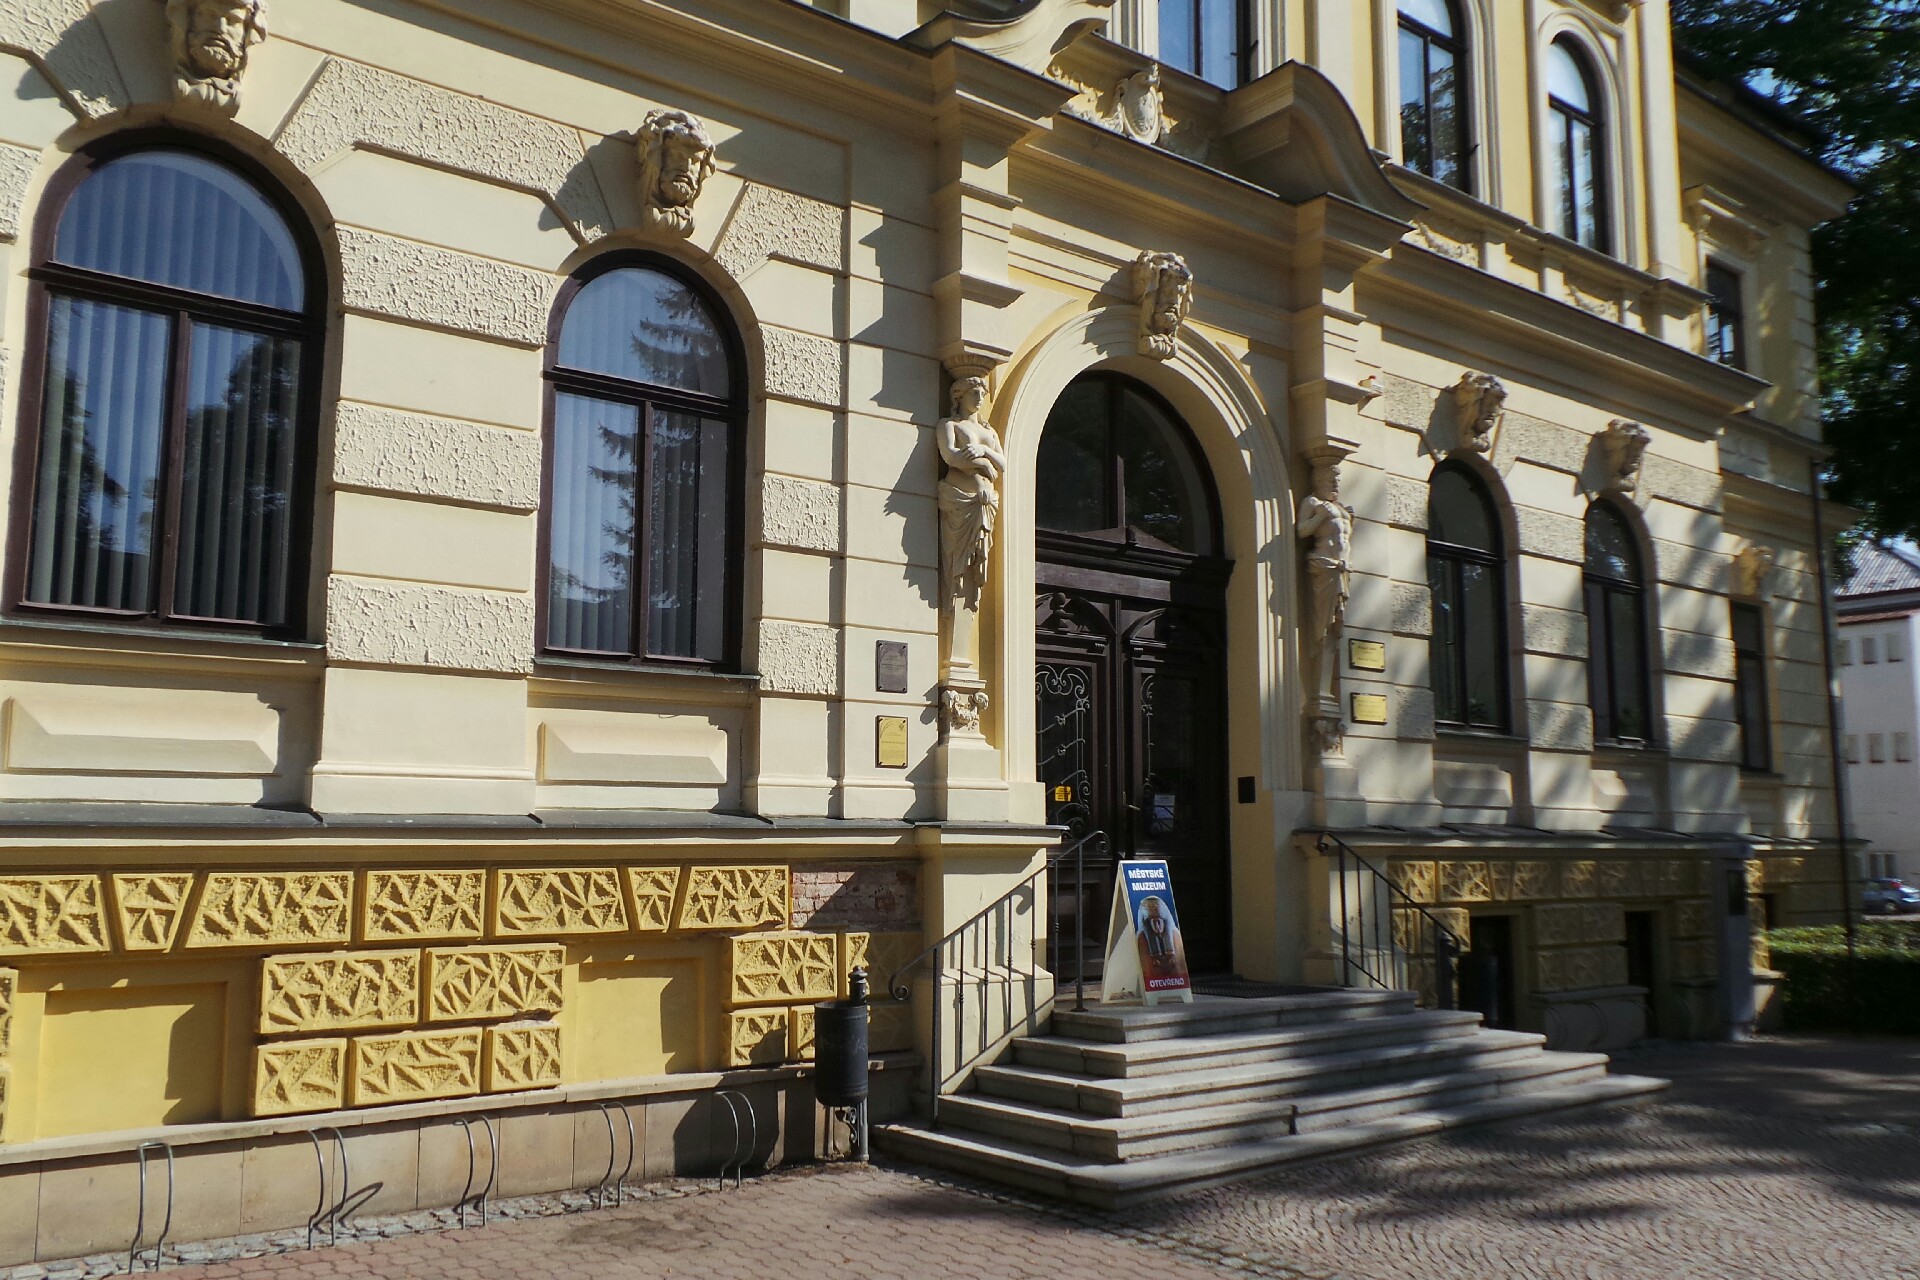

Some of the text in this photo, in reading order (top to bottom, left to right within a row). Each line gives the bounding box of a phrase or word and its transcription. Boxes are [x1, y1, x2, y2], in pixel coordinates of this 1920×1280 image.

[1128, 868, 1164, 878] MĚSTSKÉ
[1131, 882, 1166, 891] MUZEUM
[1149, 977, 1185, 988] OTEVŘENO
